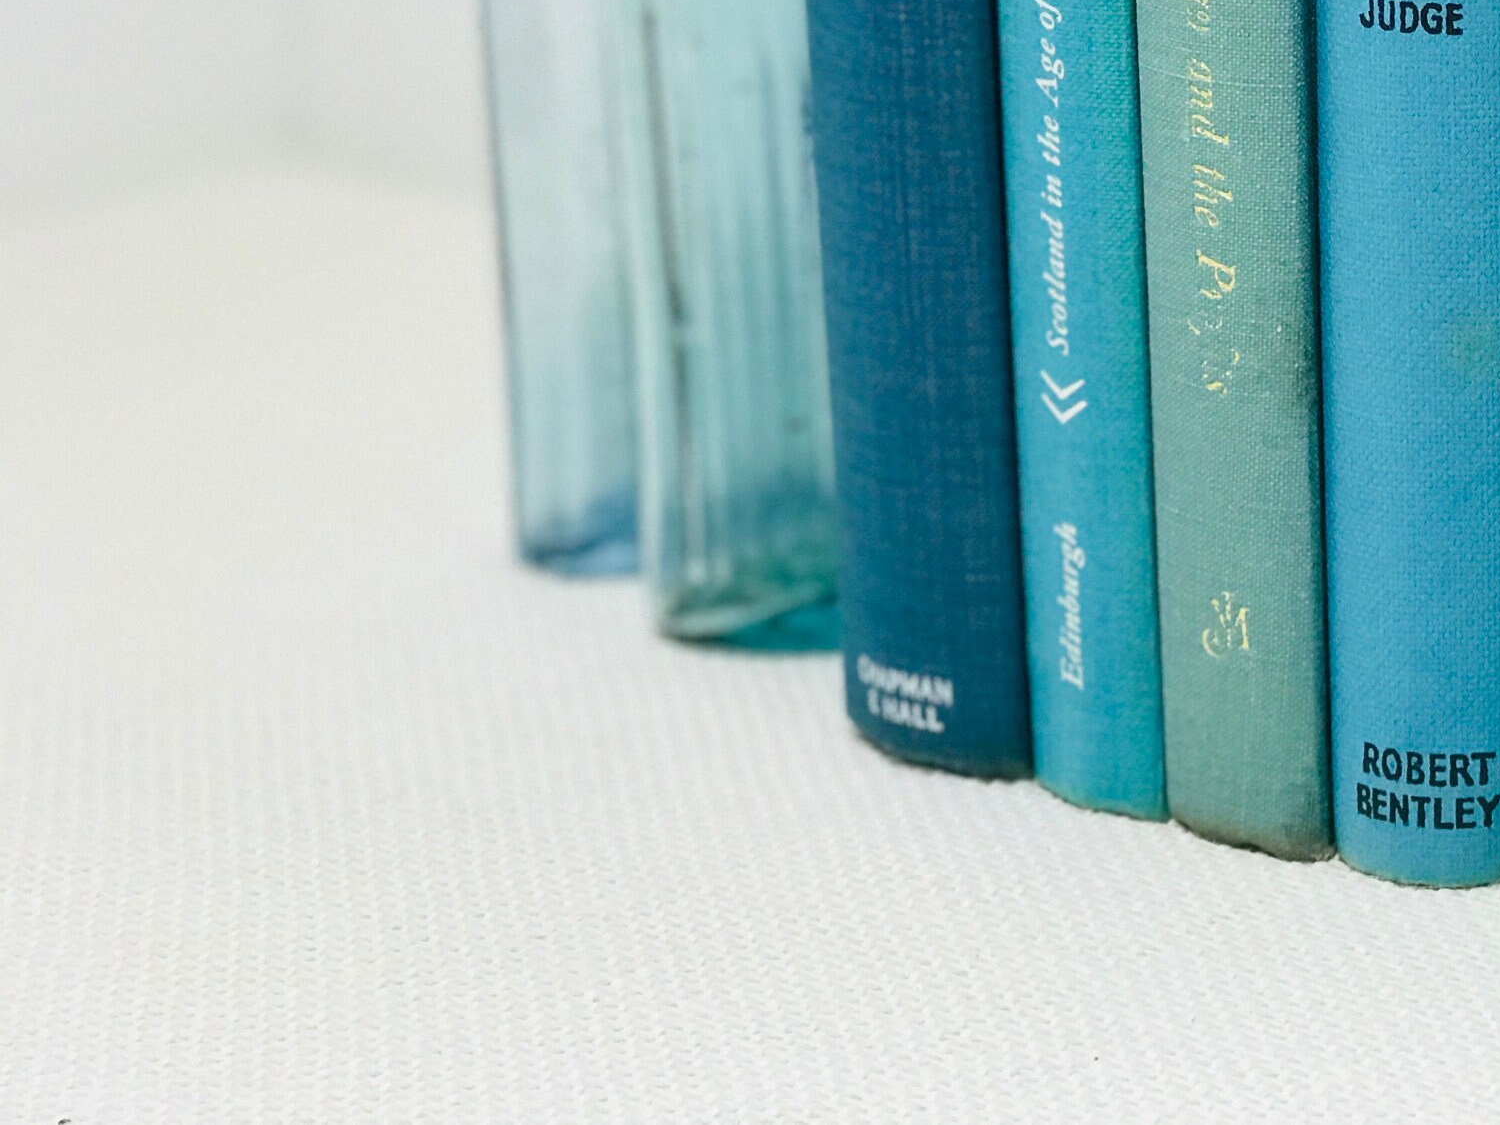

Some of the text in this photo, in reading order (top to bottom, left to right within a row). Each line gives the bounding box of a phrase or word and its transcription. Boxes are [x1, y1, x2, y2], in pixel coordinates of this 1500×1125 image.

[1035, 37, 1065, 108] Age
[1187, 58, 1229, 145] and
[1037, 115, 1061, 167] the
[1041, 174, 1062, 208] in
[1192, 164, 1233, 227] the
[1040, 210, 1069, 356] Scotland
[1053, 522, 1085, 691] Edinburgh
[1361, 742, 1497, 788] ROBERT
